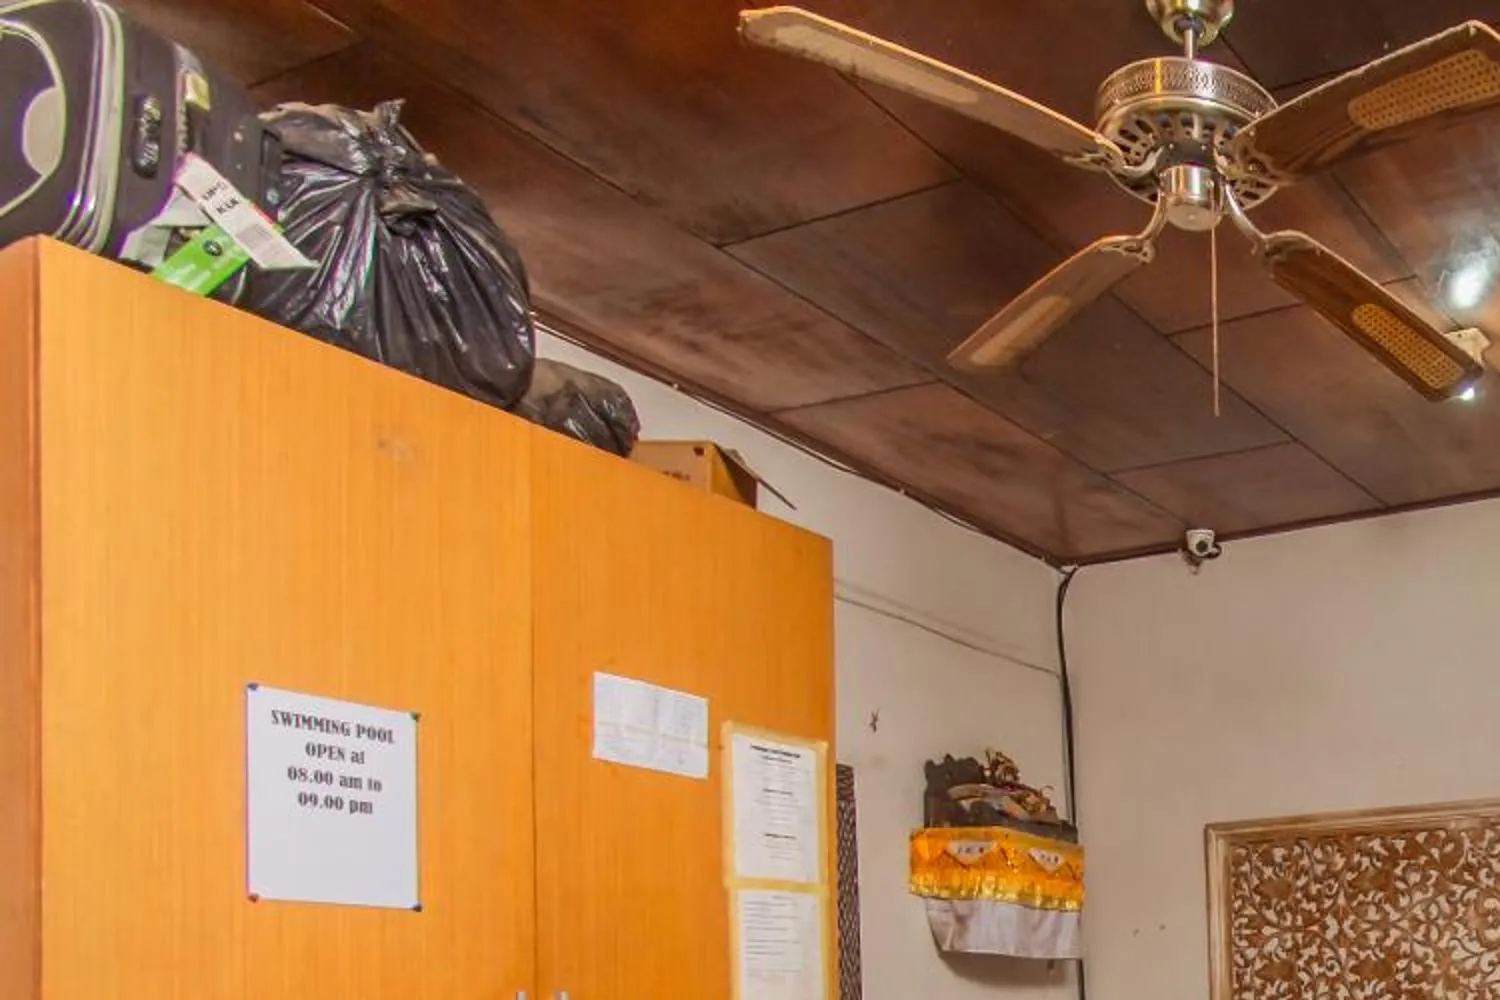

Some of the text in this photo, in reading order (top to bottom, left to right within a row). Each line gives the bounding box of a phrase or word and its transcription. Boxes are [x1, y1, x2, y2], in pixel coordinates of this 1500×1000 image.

[271, 709, 396, 744] SWIMMING POOL
[305, 742, 365, 764] OPEN at
[287, 765, 382, 793] 08.00 am to
[298, 792, 373, 815] 09.00 pm
